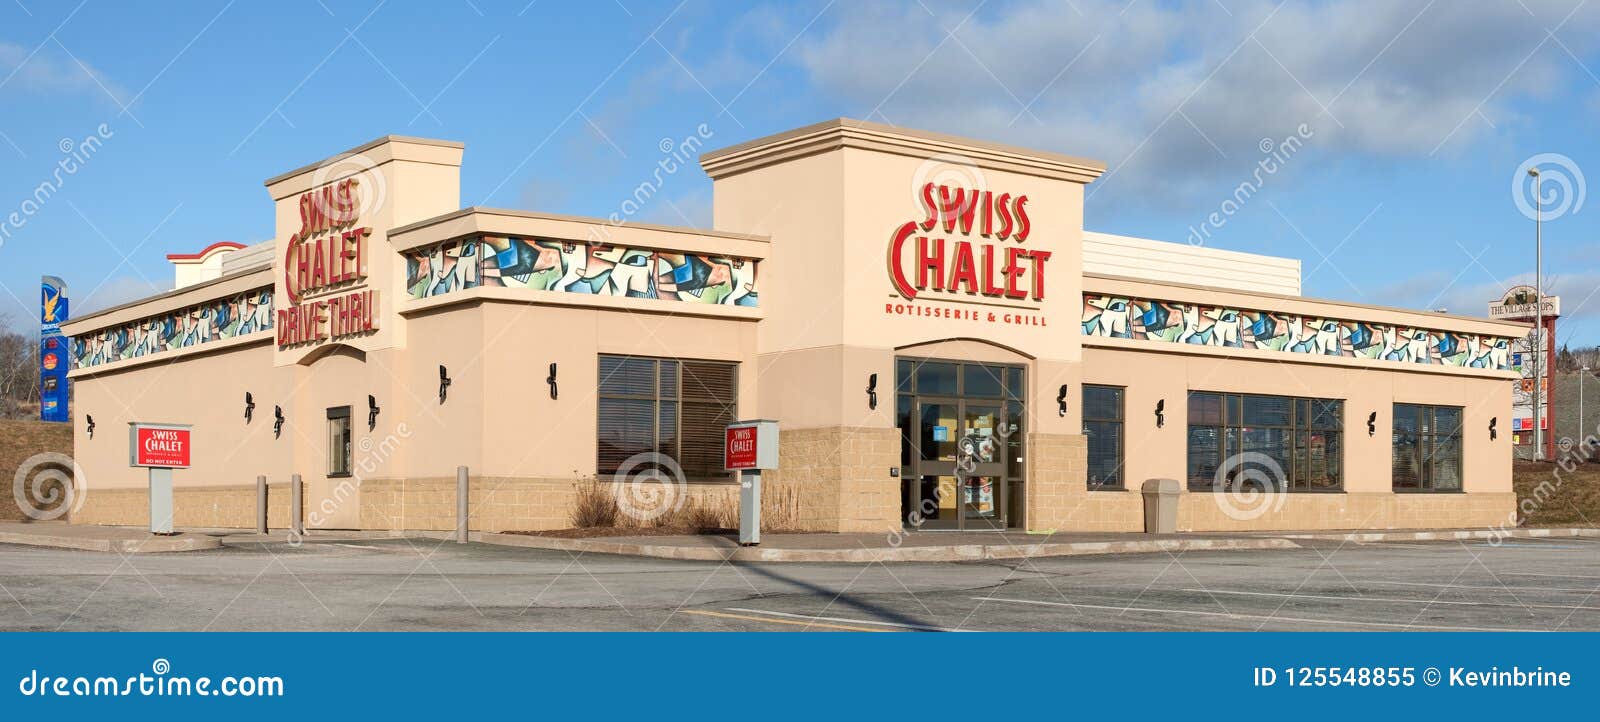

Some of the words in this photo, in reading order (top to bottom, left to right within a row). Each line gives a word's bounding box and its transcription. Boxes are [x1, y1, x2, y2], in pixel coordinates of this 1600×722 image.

[300, 178, 358, 241] SWISS
[920, 182, 1030, 242] SWISS
[285, 227, 369, 305] CHALET
[887, 220, 1052, 301] CHALET
[277, 300, 328, 348] DRIVE
[328, 289, 380, 340] THRU
[885, 303, 979, 321] ROTISSERIE
[987, 312, 996, 322] &
[1003, 313, 1048, 327] GRILL
[1490, 306, 1504, 315] THE
[1504, 302, 1532, 314] VILLAGE
[1532, 301, 1554, 312] SOPS
[145, 437, 183, 452] CHALET
[152, 430, 178, 440] SWISS
[730, 439, 753, 454] CHALET
[734, 429, 751, 440] SWISS
